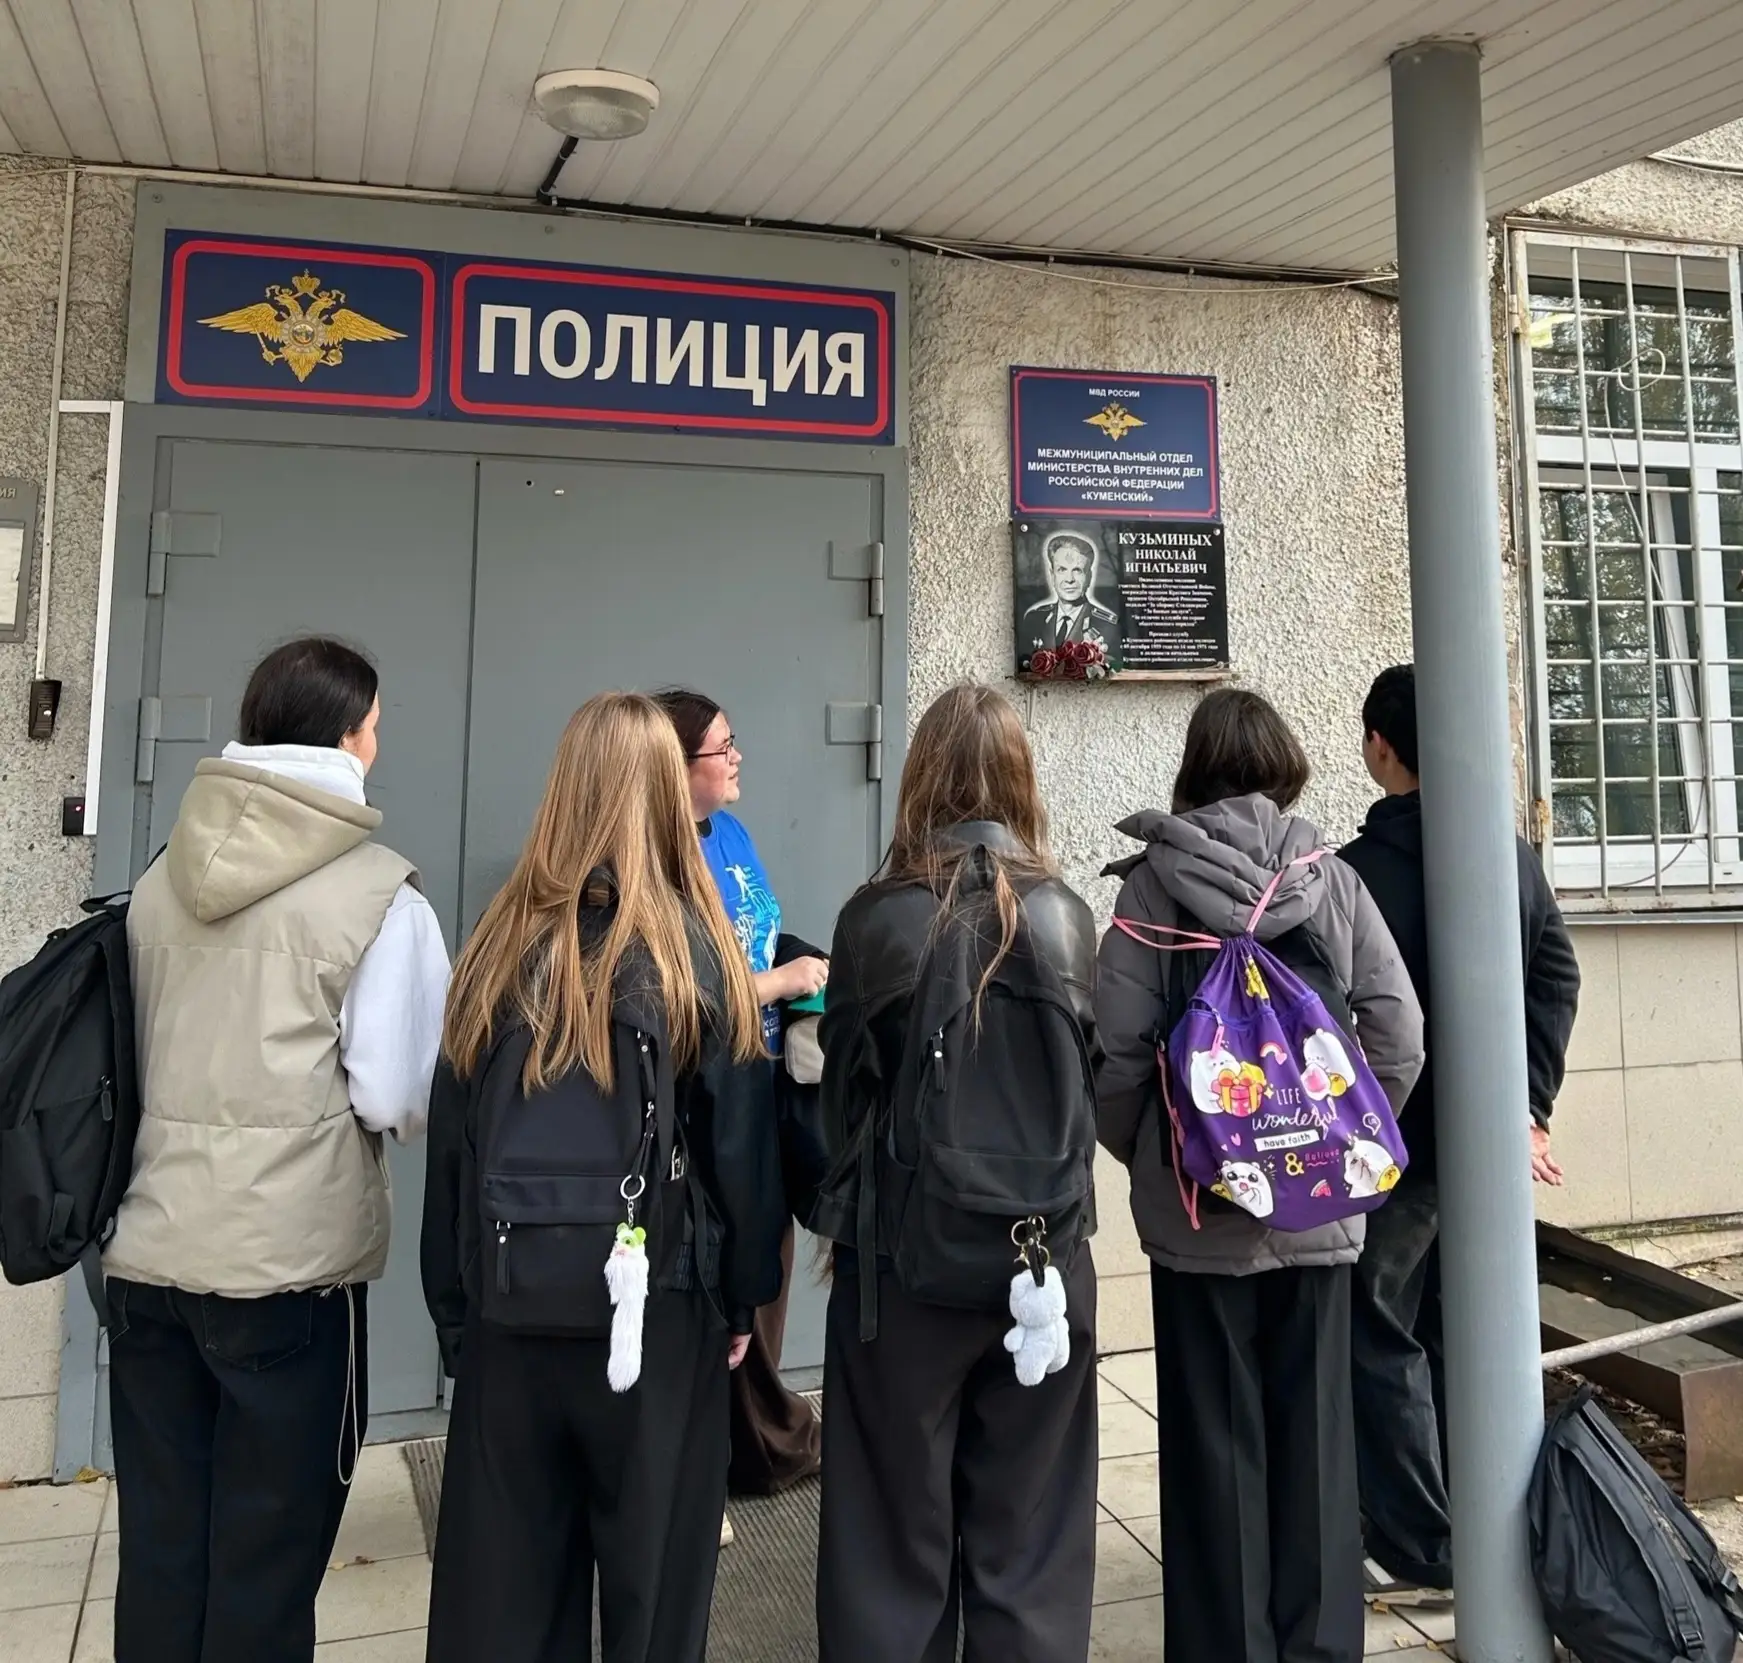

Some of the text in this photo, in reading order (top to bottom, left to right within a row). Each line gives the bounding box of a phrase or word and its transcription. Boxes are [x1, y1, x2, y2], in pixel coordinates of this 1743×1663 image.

[478, 303, 865, 407] ПОЛИЦИЯ
[1089, 388, 1140, 398] МВД РОССИИ
[1037, 448, 1193, 464] МЕЖМУНИЦИПАЛЬНЫЙ ОТДЕЛ
[1027, 461, 1203, 478] МИНИСТЕРСТВА ВНУТРЕННИХ ДЕЛ
[1048, 475, 1185, 490] РОССИЙСКОЙ ФЕДЕРАЦИИ
[1081, 490, 1154, 502] «КУМЕНСКИЙ»
[1118, 532, 1212, 547] КУЗЬМИНЫХ
[1135, 548, 1197, 561] НИКОЛАЙ
[1125, 562, 1207, 574] ИГНАТЬЕВИЧ
[1276, 1088, 1301, 1105] LIFE
[1263, 1133, 1311, 1148] have faith
[1284, 1152, 1304, 1176] &
